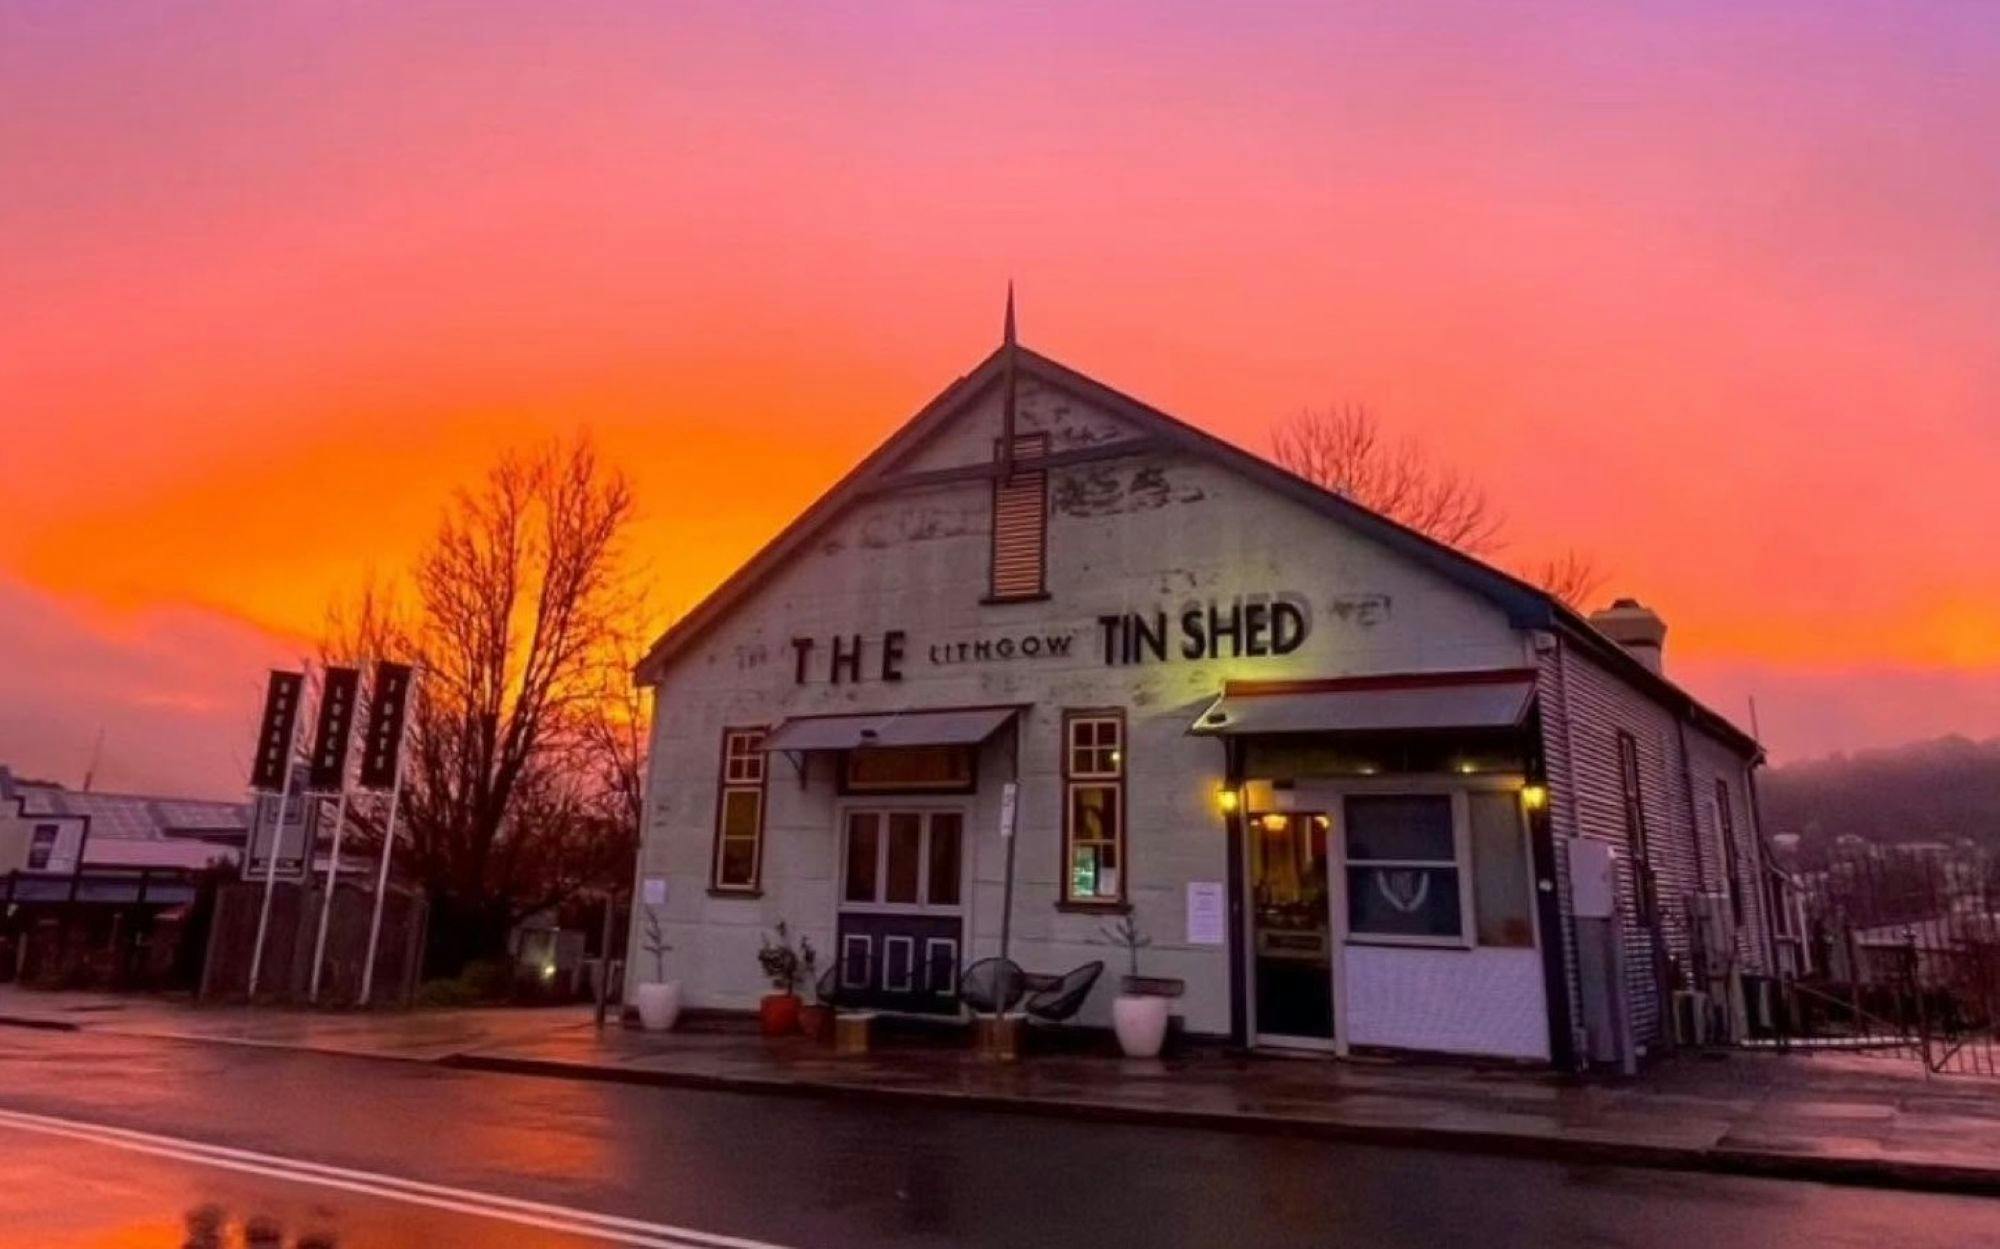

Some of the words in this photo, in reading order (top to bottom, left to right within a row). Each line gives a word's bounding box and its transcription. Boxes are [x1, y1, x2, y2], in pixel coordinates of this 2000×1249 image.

[792, 630, 904, 684] THE
[929, 635, 1073, 665] LITHGOW
[1098, 611, 1167, 665] TIN
[1181, 601, 1306, 660] SHED
